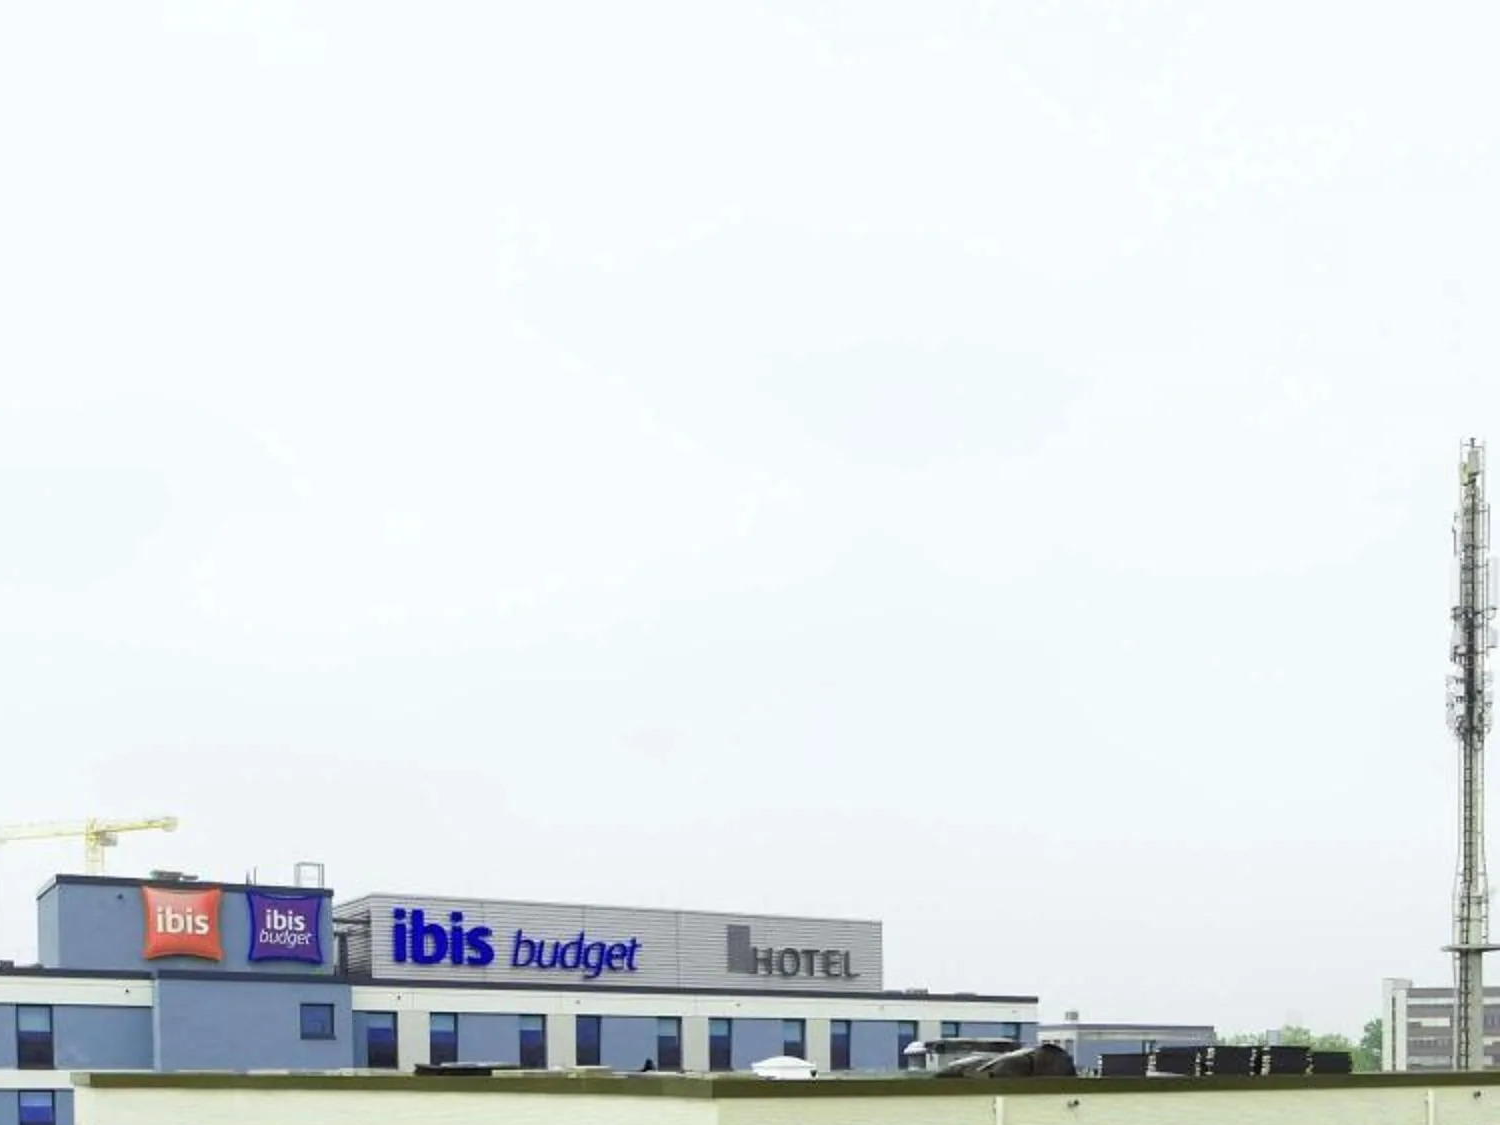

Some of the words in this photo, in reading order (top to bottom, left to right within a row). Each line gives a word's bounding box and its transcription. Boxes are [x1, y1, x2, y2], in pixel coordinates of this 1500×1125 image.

[156, 906, 210, 935] ibis
[265, 909, 305, 931] ibis
[259, 929, 312, 949] budget
[392, 908, 495, 967] ibis
[511, 927, 643, 980] budget
[751, 946, 861, 977] HOTEL
